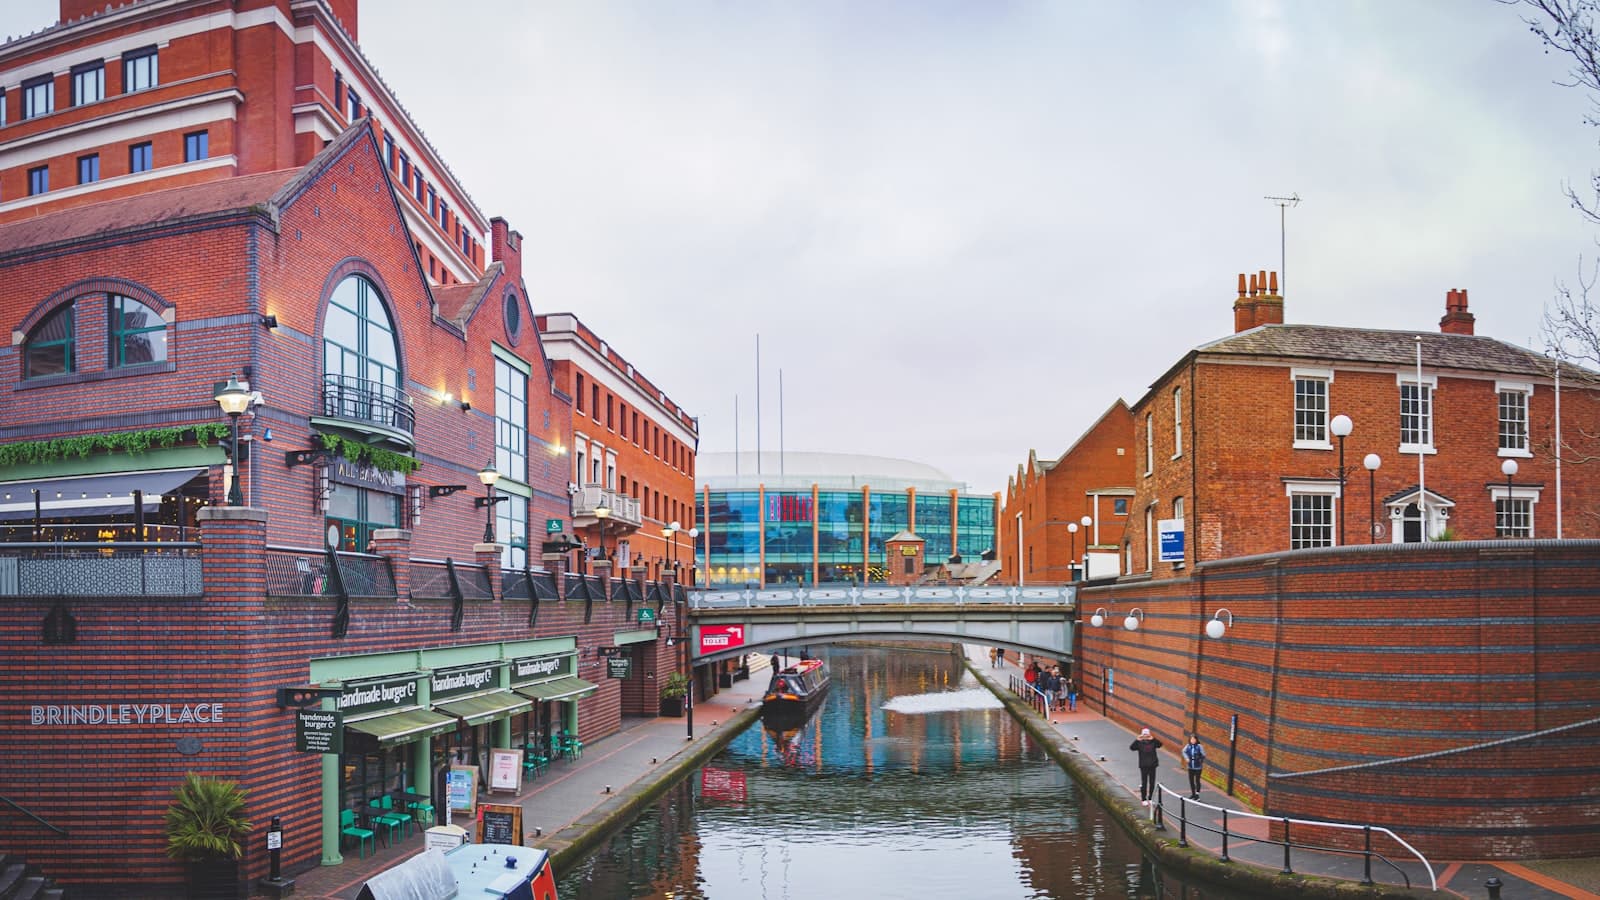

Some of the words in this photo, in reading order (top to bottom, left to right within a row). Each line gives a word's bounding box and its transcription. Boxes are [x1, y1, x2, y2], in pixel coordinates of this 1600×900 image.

[338, 463, 356, 478] ALL
[518, 661, 540, 676] handmade
[540, 660, 555, 674] burger
[432, 673, 465, 692] handmade
[466, 672, 485, 688] burger
[337, 685, 381, 707] handmade
[382, 684, 407, 704] burger
[31, 703, 224, 725] BRINDLEYPLACE
[300, 712, 334, 721] handmade
[304, 720, 327, 729] burger
